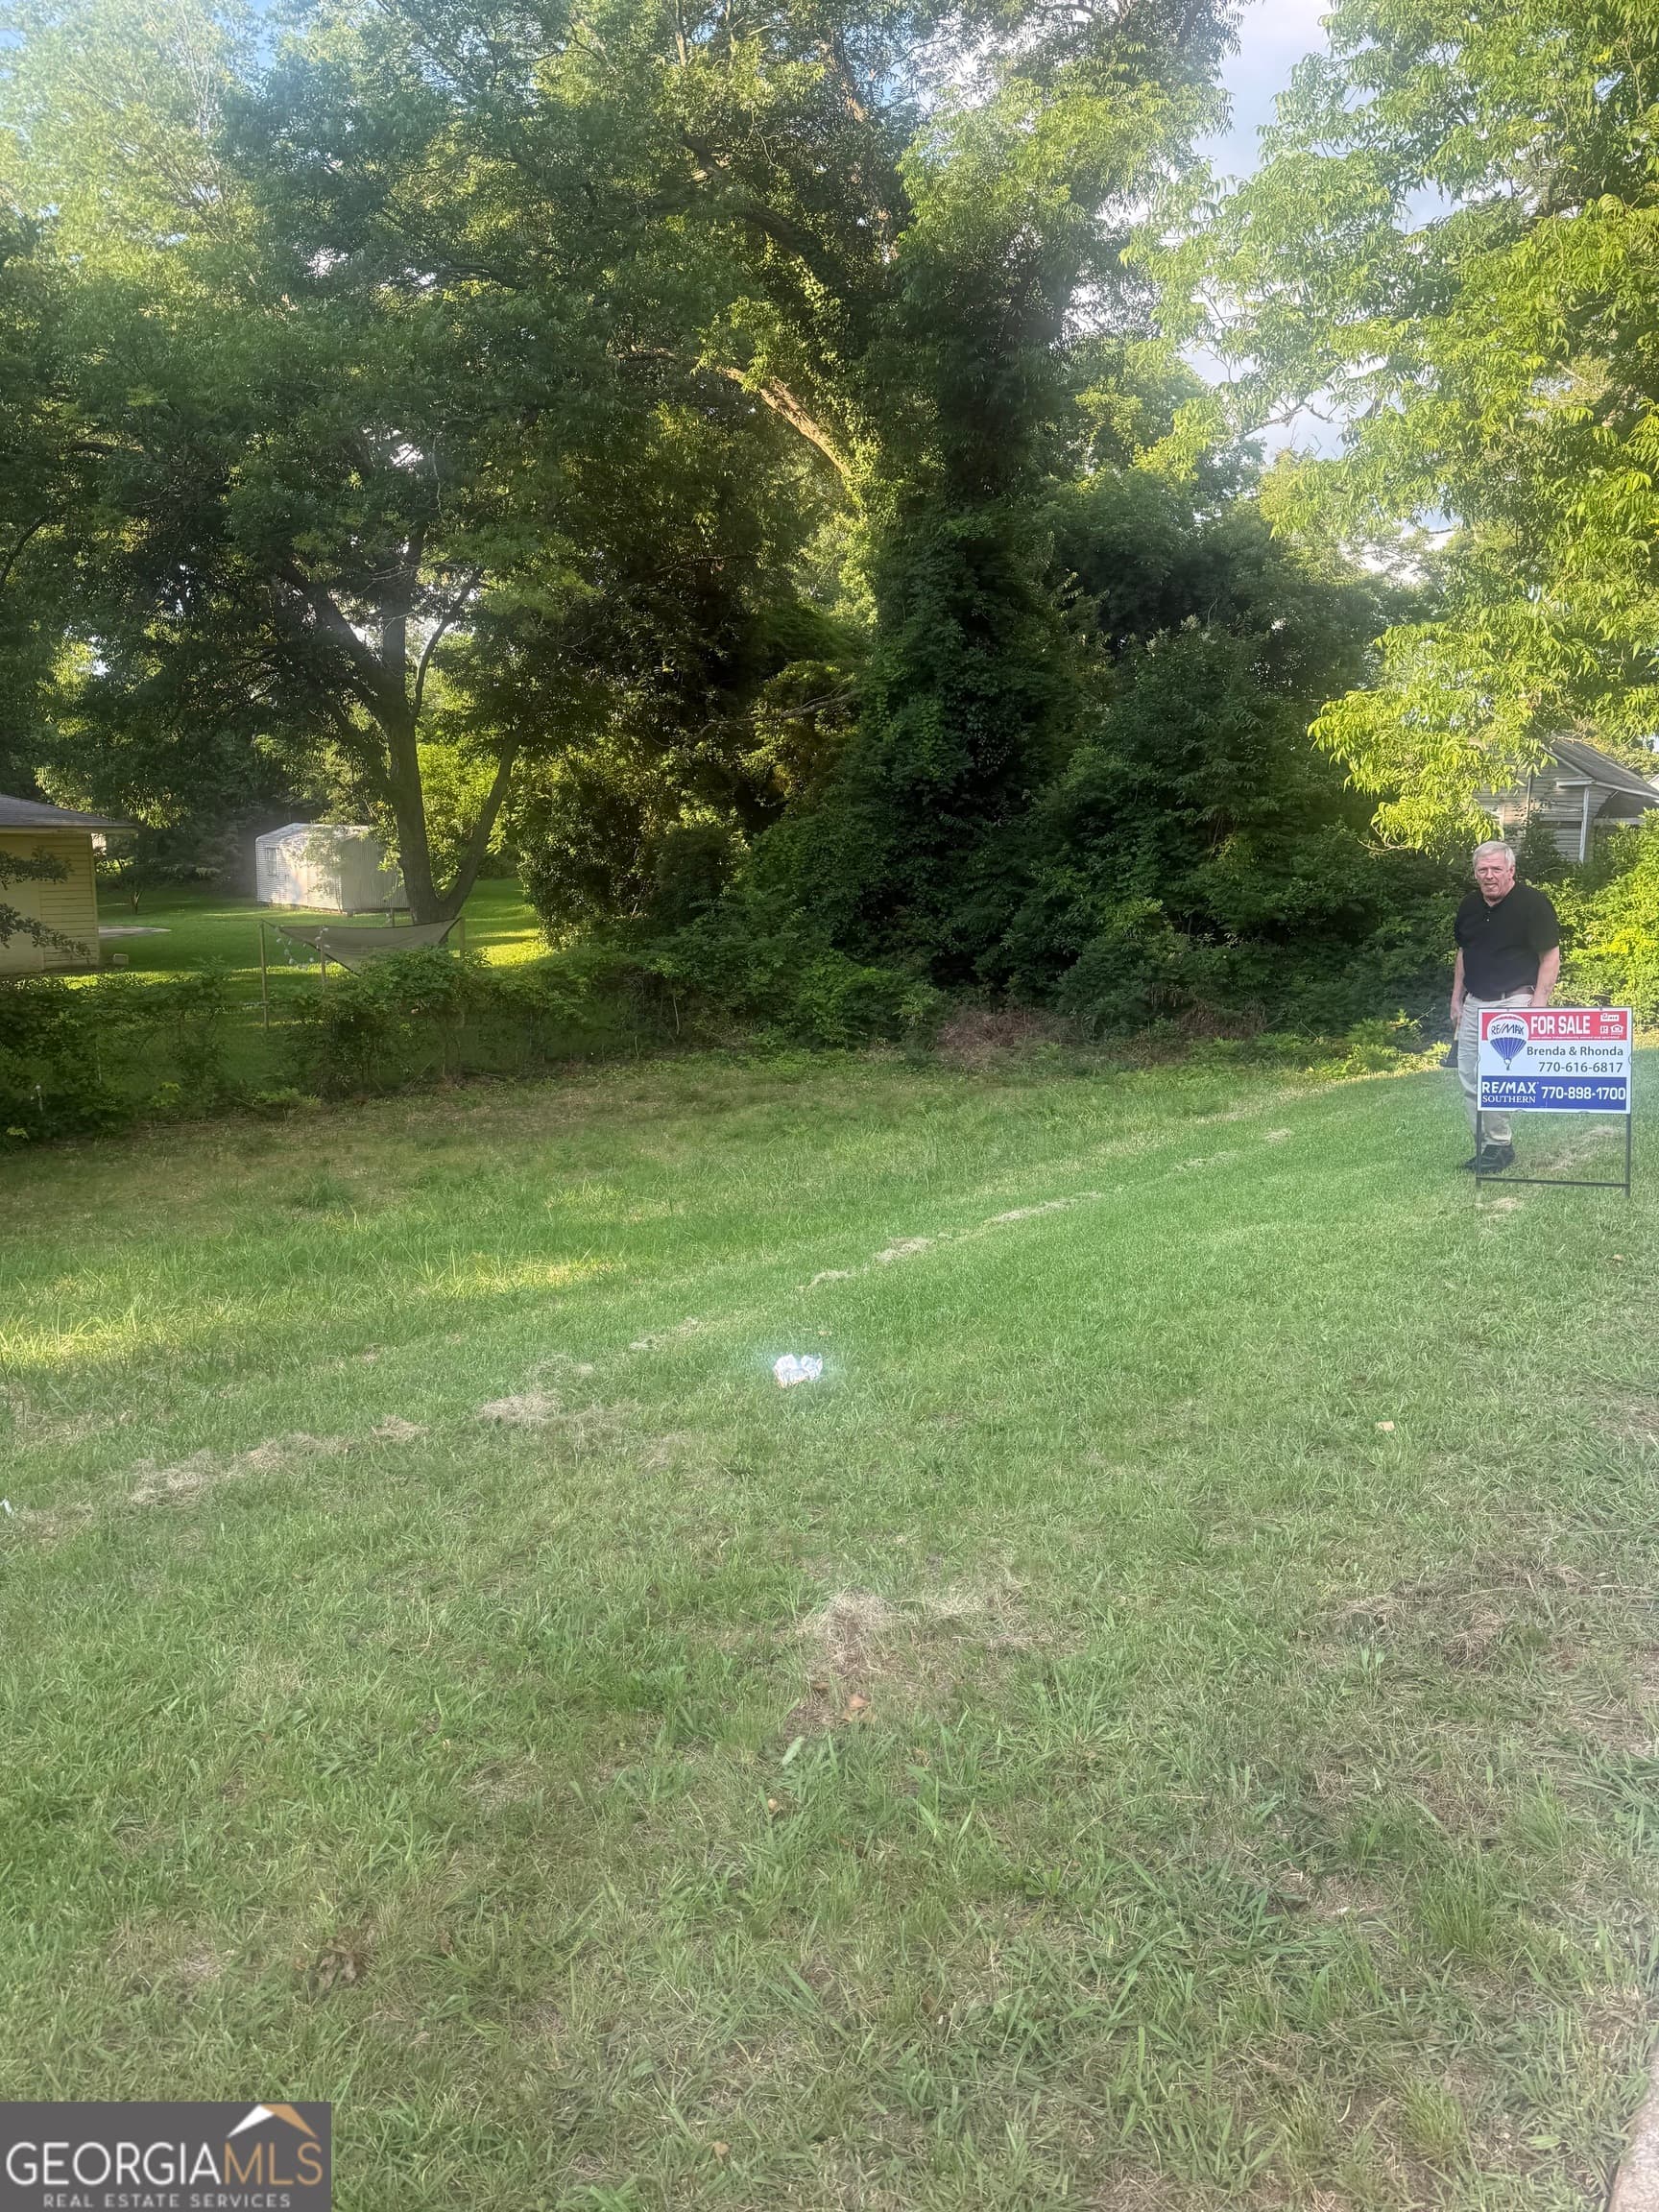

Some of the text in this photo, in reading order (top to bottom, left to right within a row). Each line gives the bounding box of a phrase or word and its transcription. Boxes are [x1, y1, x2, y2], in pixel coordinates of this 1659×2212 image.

[1491, 1022, 1525, 1036] RE/MAX
[1530, 1016, 1555, 1034] FOR
[1558, 1016, 1590, 1034] SALE
[1527, 1046, 1623, 1056] Brenda & Rhonda
[1538, 1062, 1623, 1072] 770-616-6817
[1481, 1081, 1536, 1094] RE/MAX
[1541, 1086, 1626, 1100] 770-898-1700
